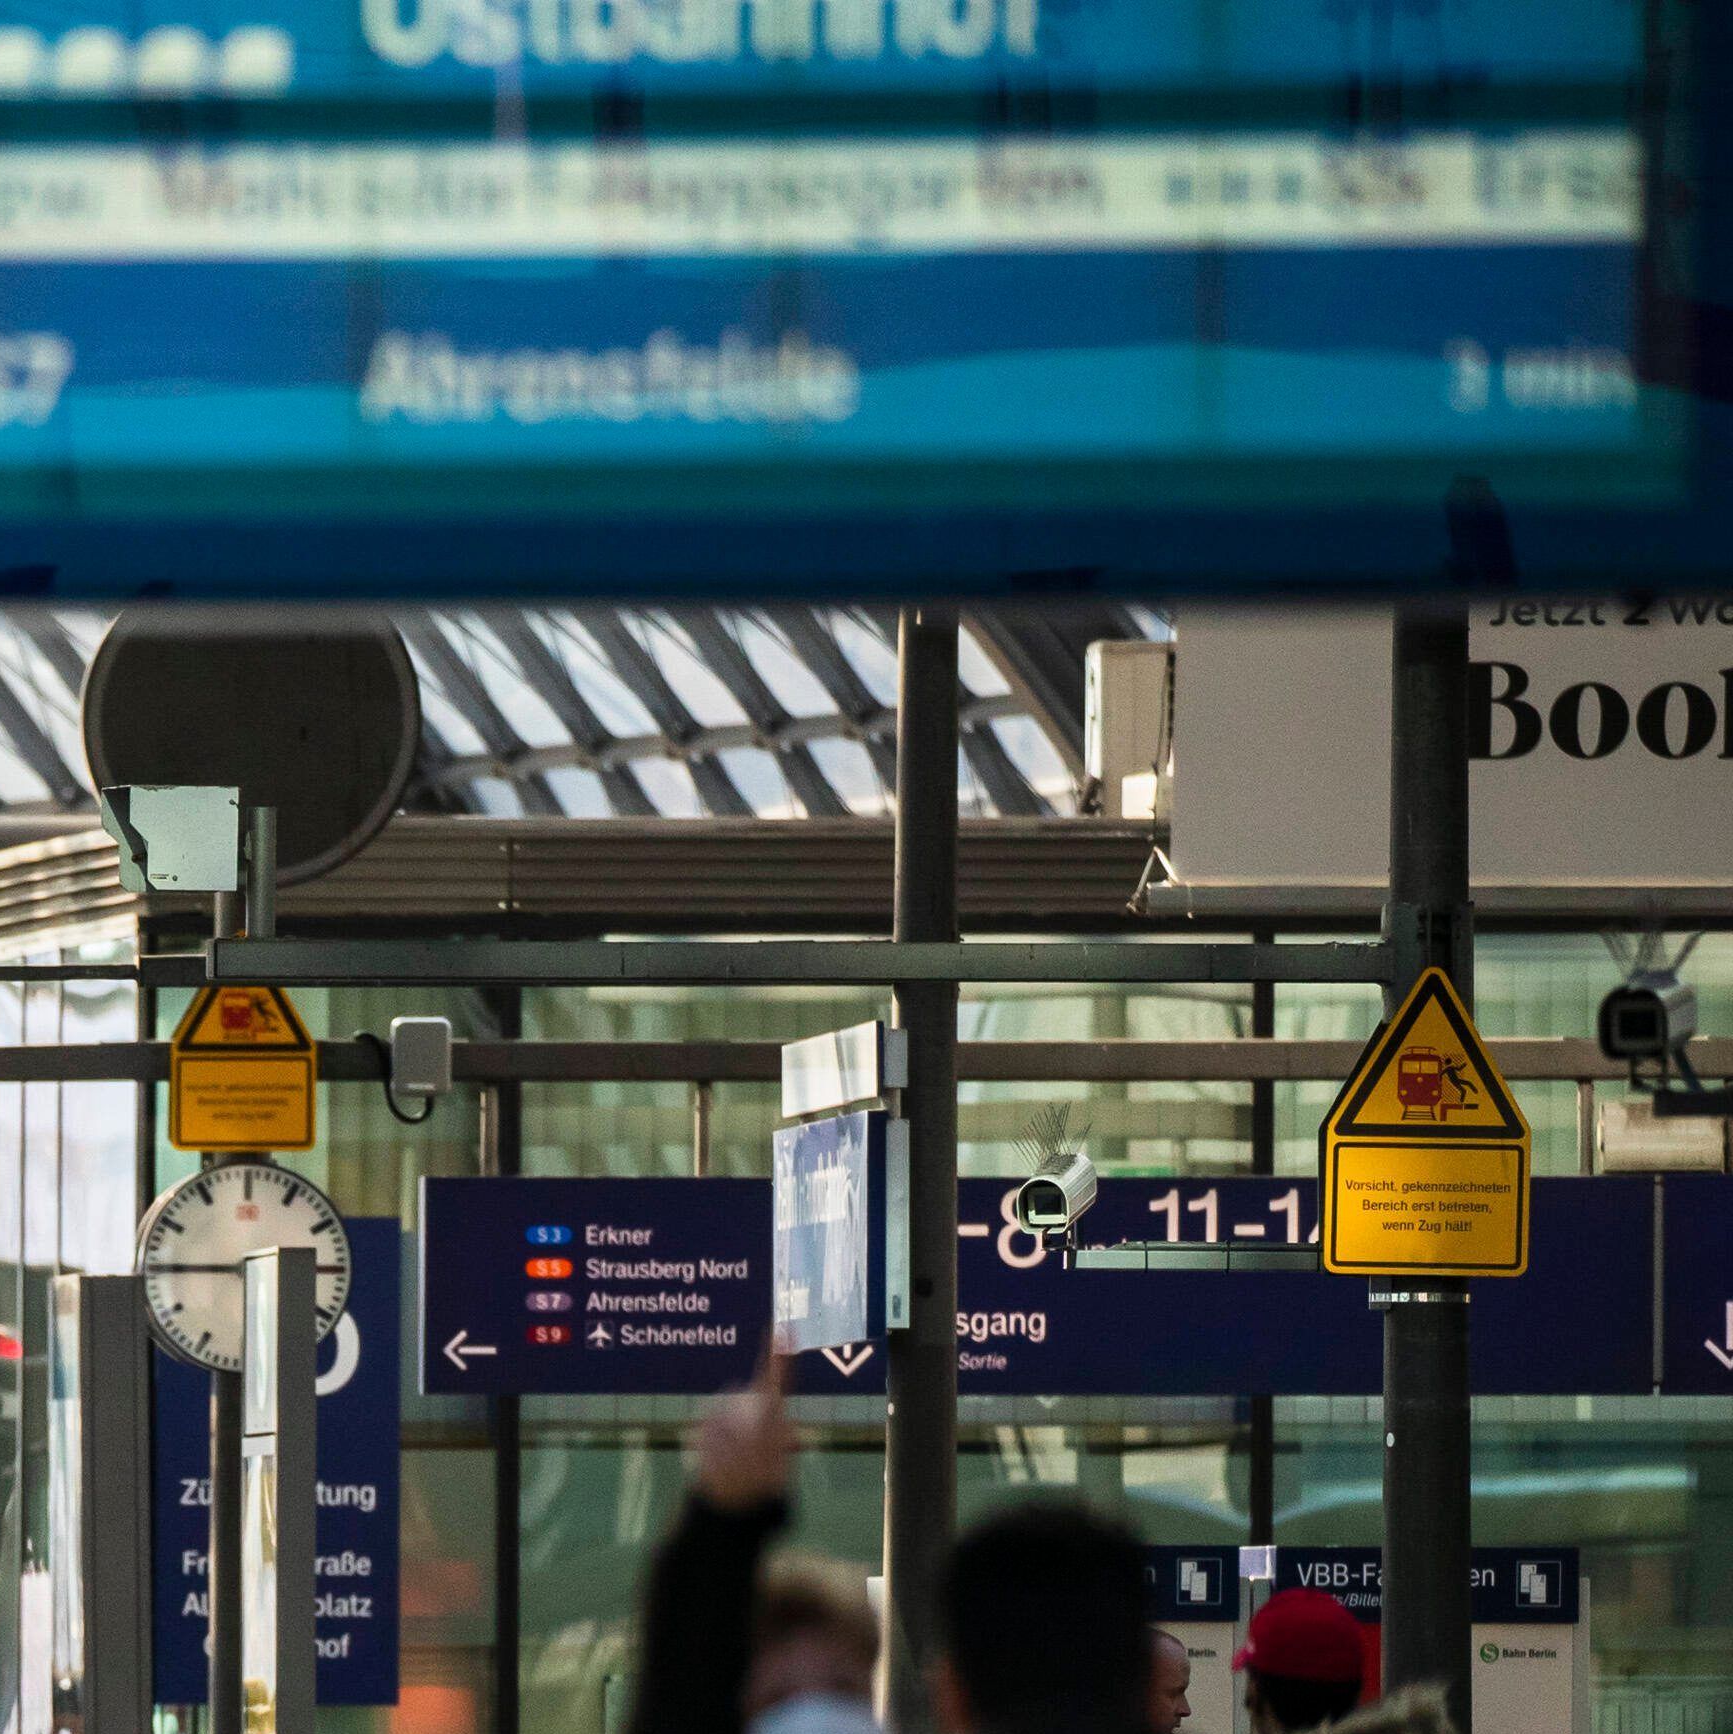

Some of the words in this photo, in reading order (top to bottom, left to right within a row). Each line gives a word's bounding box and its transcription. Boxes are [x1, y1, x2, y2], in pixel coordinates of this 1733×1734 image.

[1345, 1179, 1397, 1193] Vorsicht,
[1401, 1180, 1511, 1195] gekennzeichneten
[1362, 1199, 1408, 1212] Bereich
[1411, 1201, 1436, 1212] erst
[1438, 1202, 1493, 1214] betreten,
[585, 1224, 652, 1247] Erkner
[1382, 1221, 1414, 1232] wenn
[1417, 1219, 1441, 1234] Zug
[585, 1258, 695, 1284] Strausberg
[699, 1258, 748, 1280] Nord
[585, 1292, 710, 1313] Ahrensfelde
[620, 1324, 737, 1346] Schönefeld
[956, 1311, 1047, 1343] sgang
[958, 1352, 1008, 1371] Sortie
